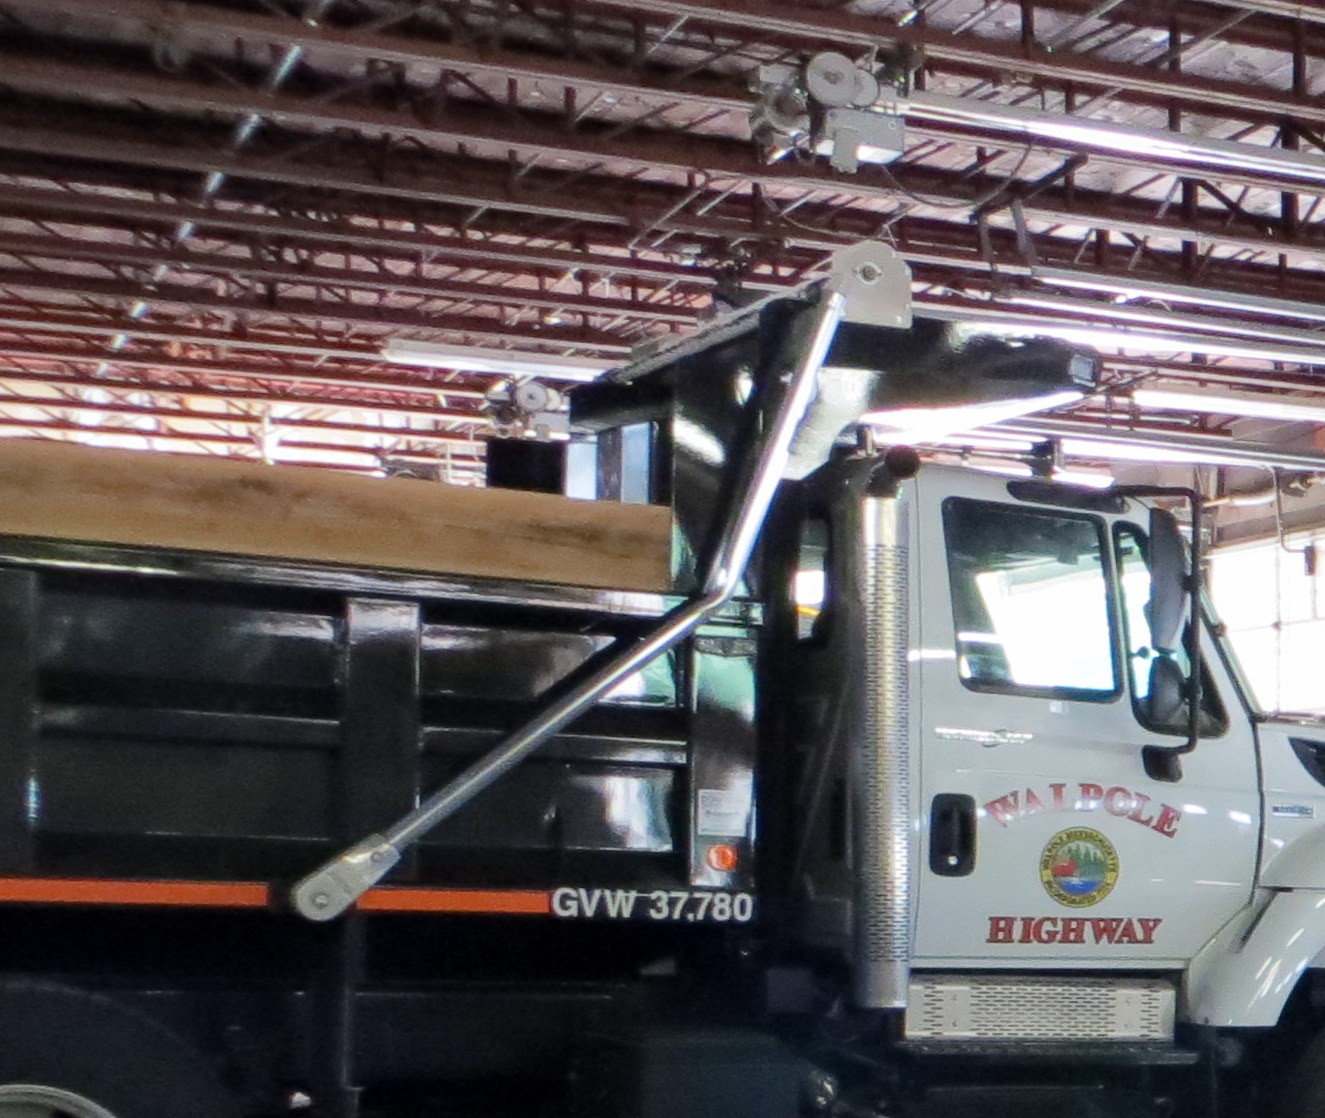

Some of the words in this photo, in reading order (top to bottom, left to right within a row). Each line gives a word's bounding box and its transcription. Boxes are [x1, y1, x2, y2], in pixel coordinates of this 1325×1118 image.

[984, 783, 1182, 838] WALPOLE
[552, 887, 637, 917] GVW
[650, 890, 754, 922] 37,780
[986, 916, 1162, 944] HIGHWAY
